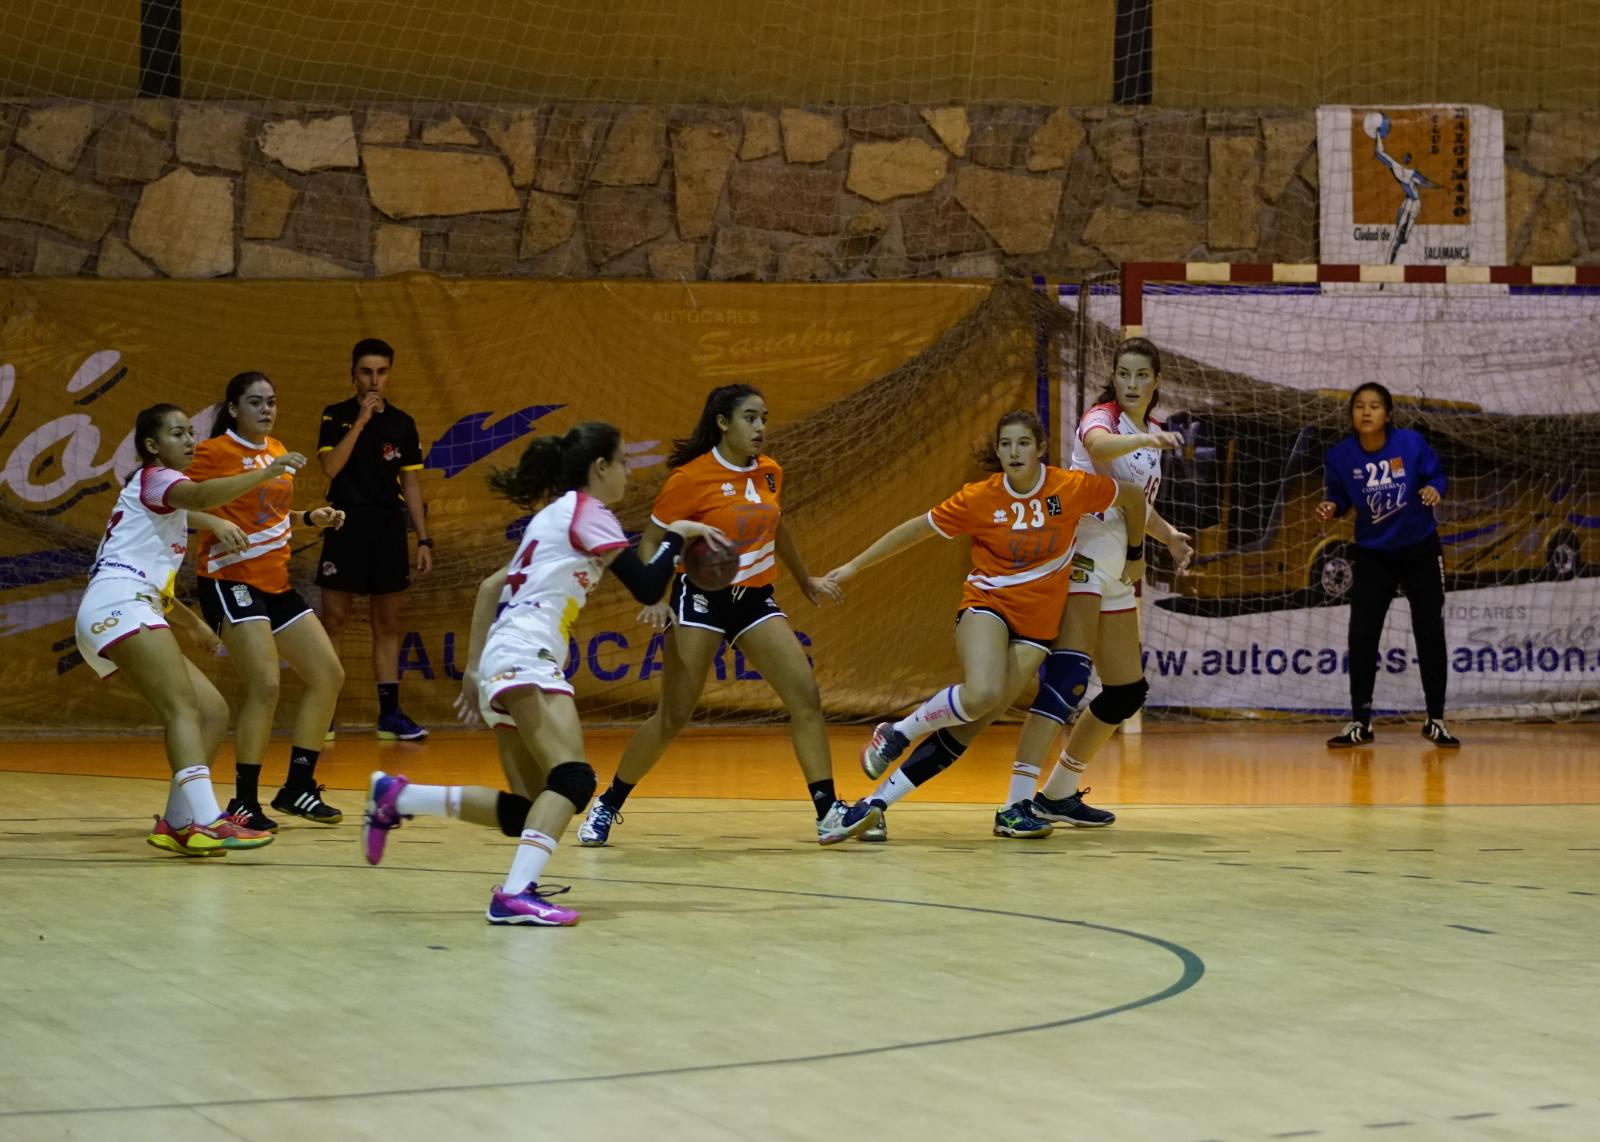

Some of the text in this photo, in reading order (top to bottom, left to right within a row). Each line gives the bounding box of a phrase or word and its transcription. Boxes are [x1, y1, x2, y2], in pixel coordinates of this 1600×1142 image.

[1353, 227, 1391, 242] Ciudad de
[651, 309, 761, 325] AUTOCARES
[1364, 460, 1392, 487] 22
[743, 477, 763, 505] 4
[1366, 483, 1408, 520] Gil
[1010, 498, 1046, 531] 23
[505, 539, 540, 597] 4
[90, 616, 120, 636] GO
